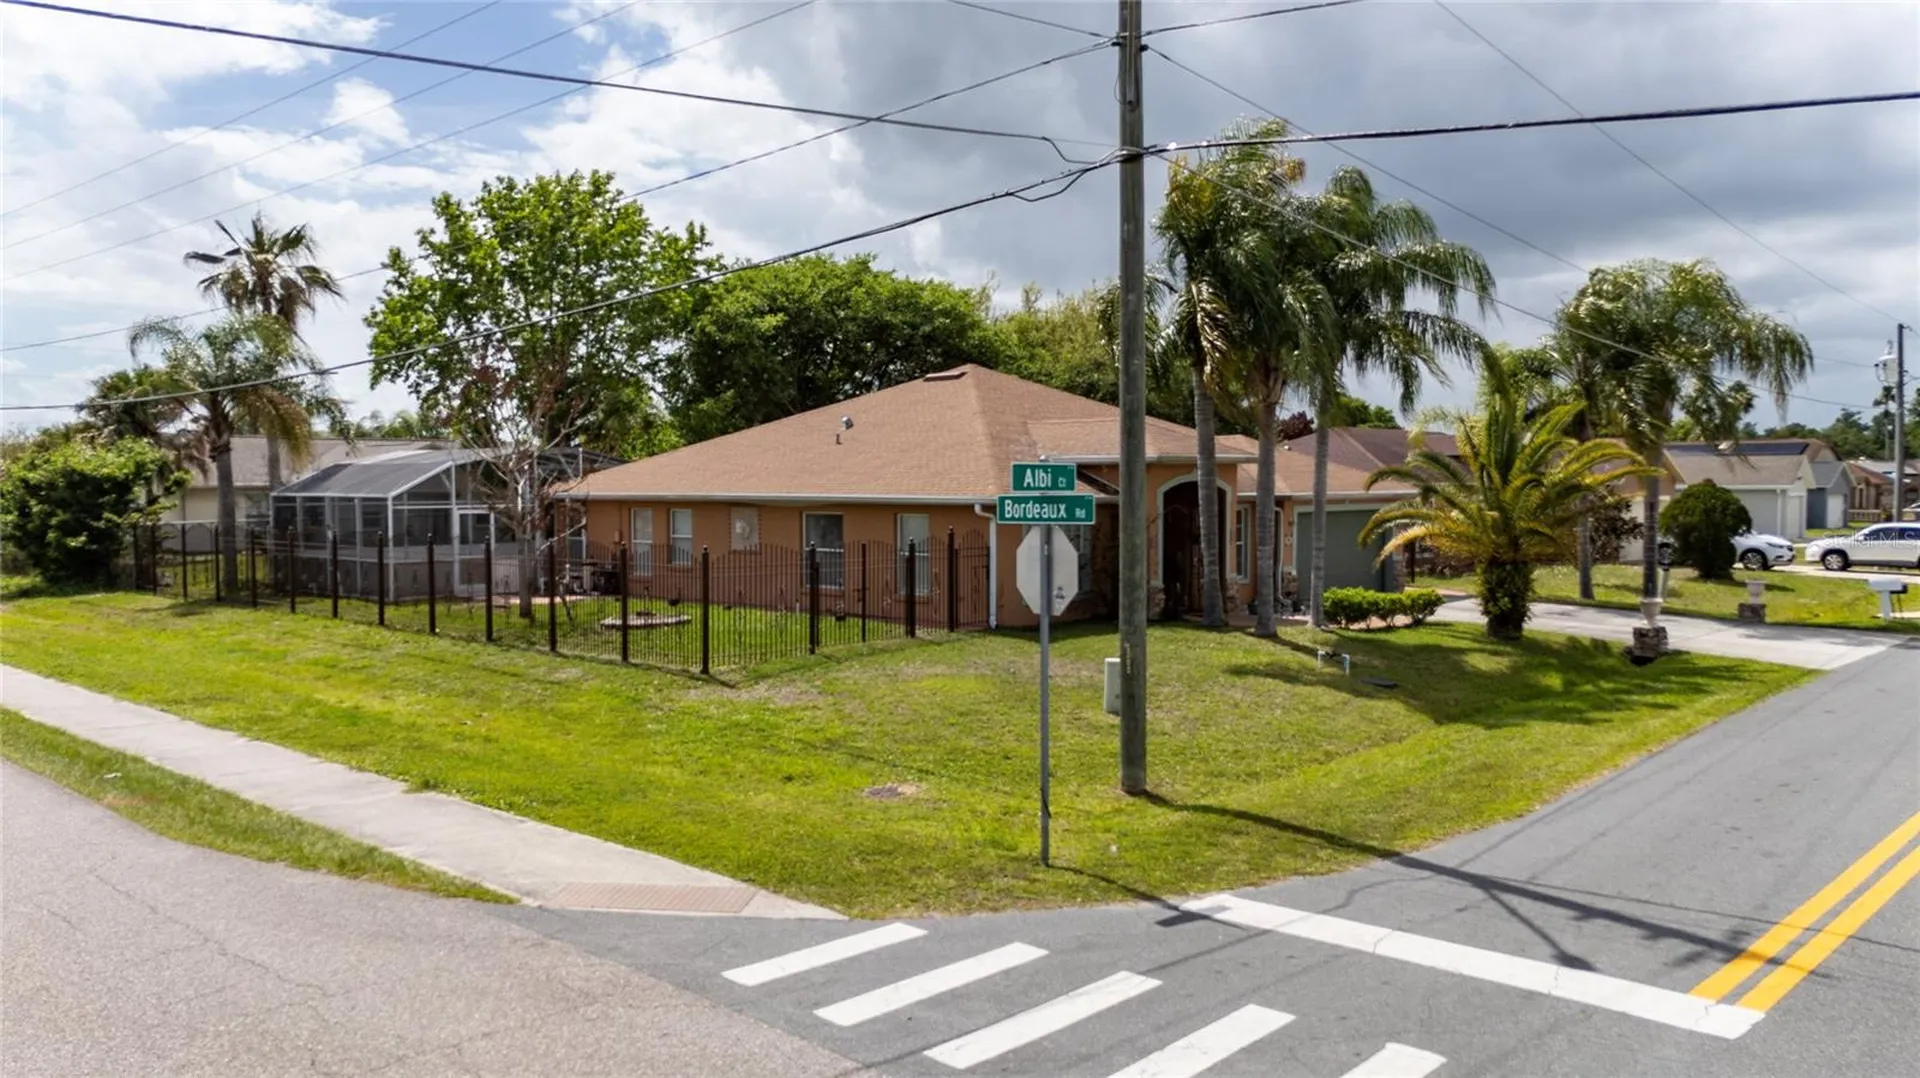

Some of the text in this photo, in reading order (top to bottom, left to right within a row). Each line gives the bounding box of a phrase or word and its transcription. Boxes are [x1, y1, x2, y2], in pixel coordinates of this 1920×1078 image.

[1024, 468, 1052, 487] Albi
[1005, 499, 1086, 519] Bordeaux Rd
